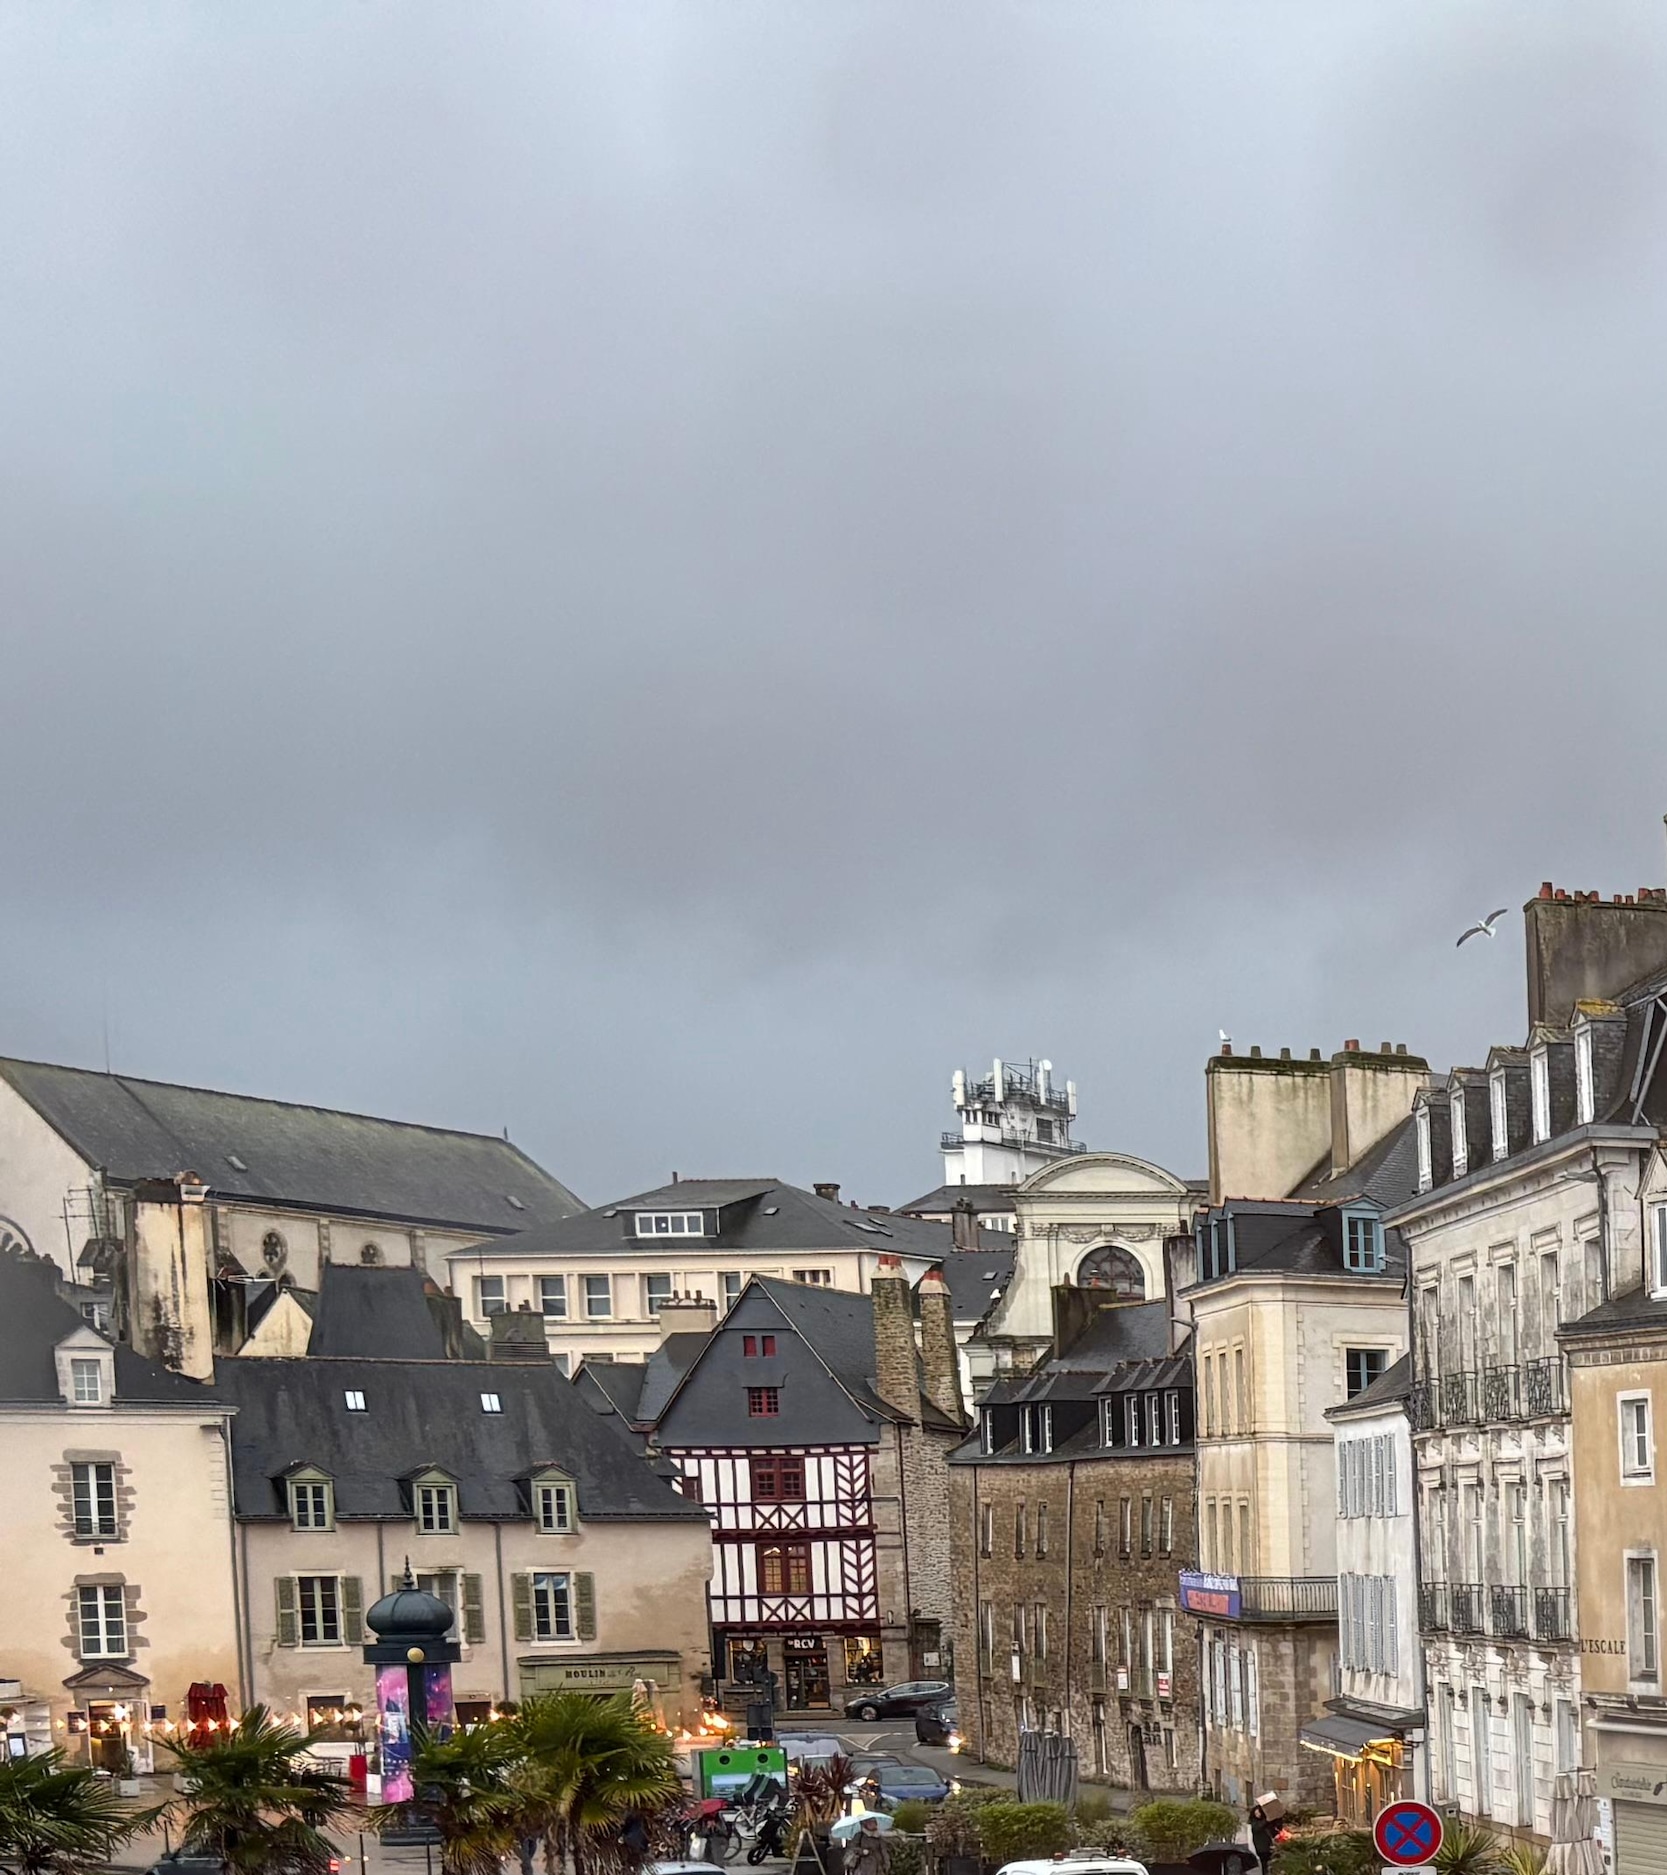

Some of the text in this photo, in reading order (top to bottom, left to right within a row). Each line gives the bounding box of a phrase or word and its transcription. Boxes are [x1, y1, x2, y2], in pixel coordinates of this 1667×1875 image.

[794, 1639, 815, 1649] RCV
[1581, 1639, 1626, 1654] L'ESCALE
[565, 1669, 606, 1679] MOULIN
